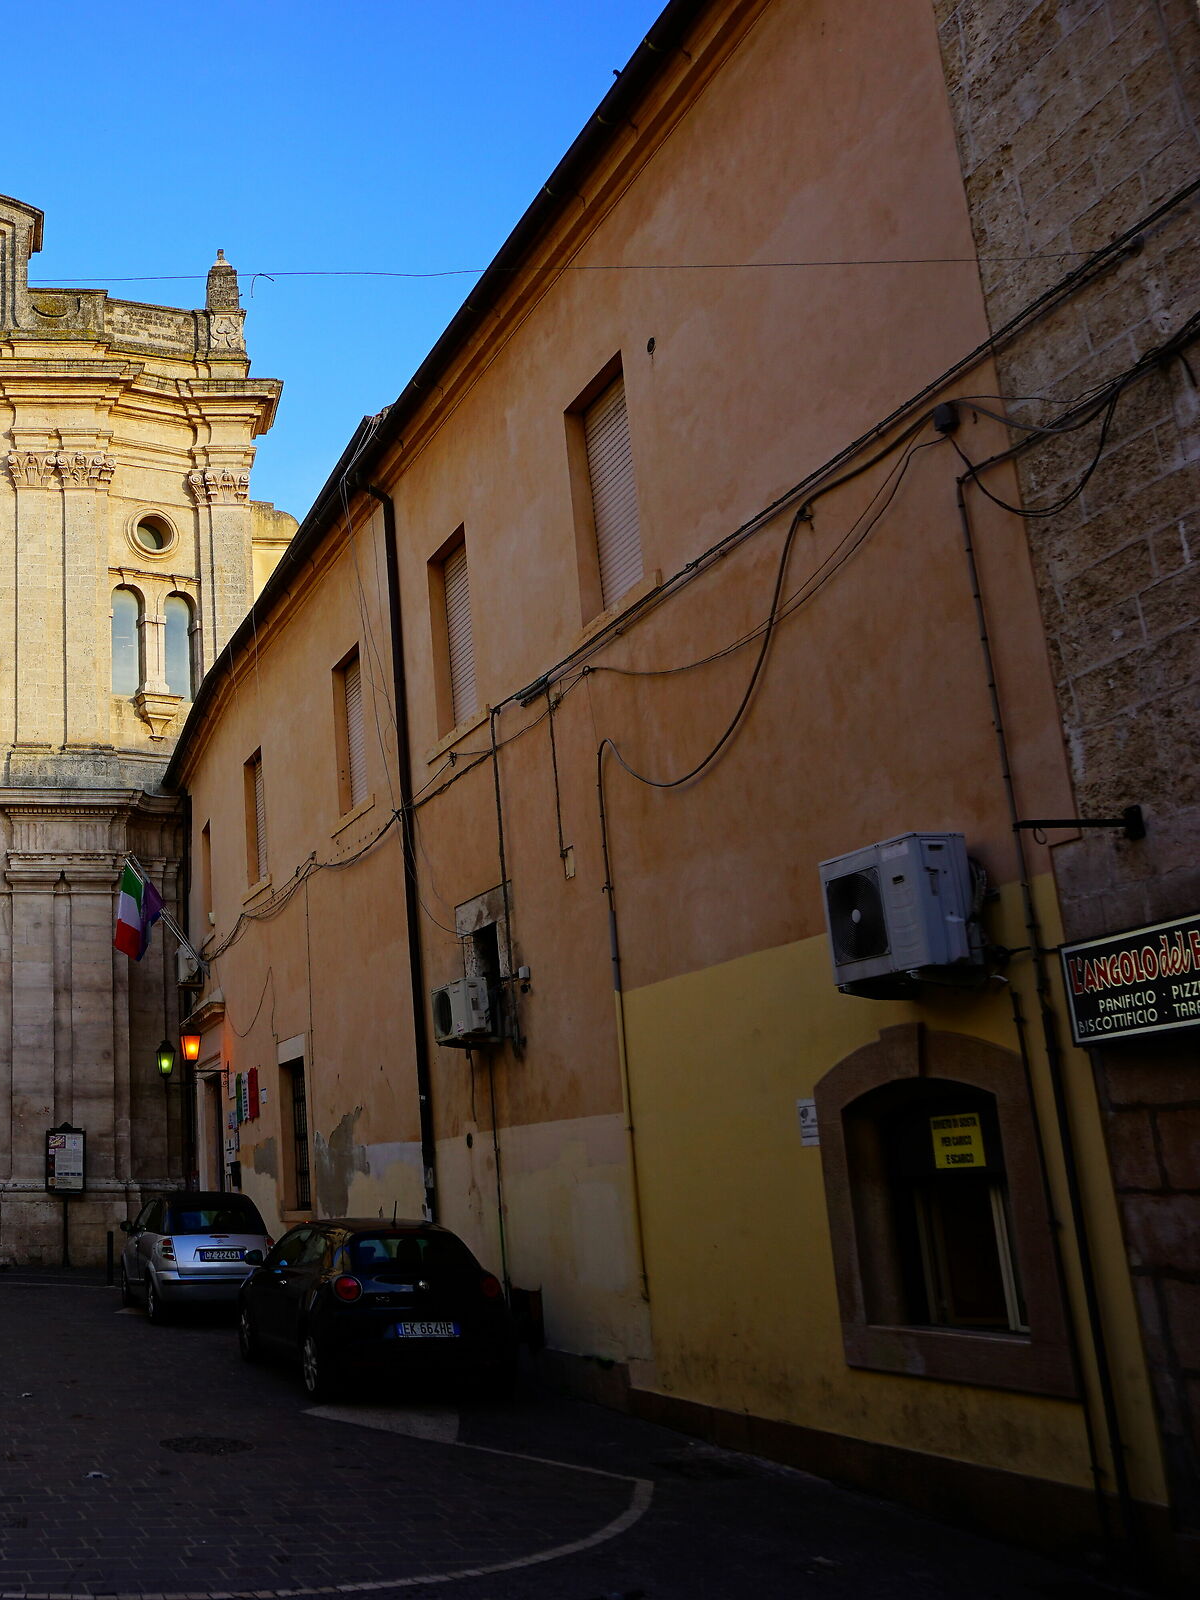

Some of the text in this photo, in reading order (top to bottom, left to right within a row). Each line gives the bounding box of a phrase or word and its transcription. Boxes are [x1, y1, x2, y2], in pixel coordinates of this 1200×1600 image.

[1068, 945, 1159, 996] L'ANGOLO
[1158, 930, 1191, 978] del
[1098, 990, 1157, 1013] PANIFICIO
[1077, 1007, 1159, 1034] BISCOTTIFICIO
[403, 1321, 417, 1335] EK
[420, 1321, 454, 1335] 664HE
